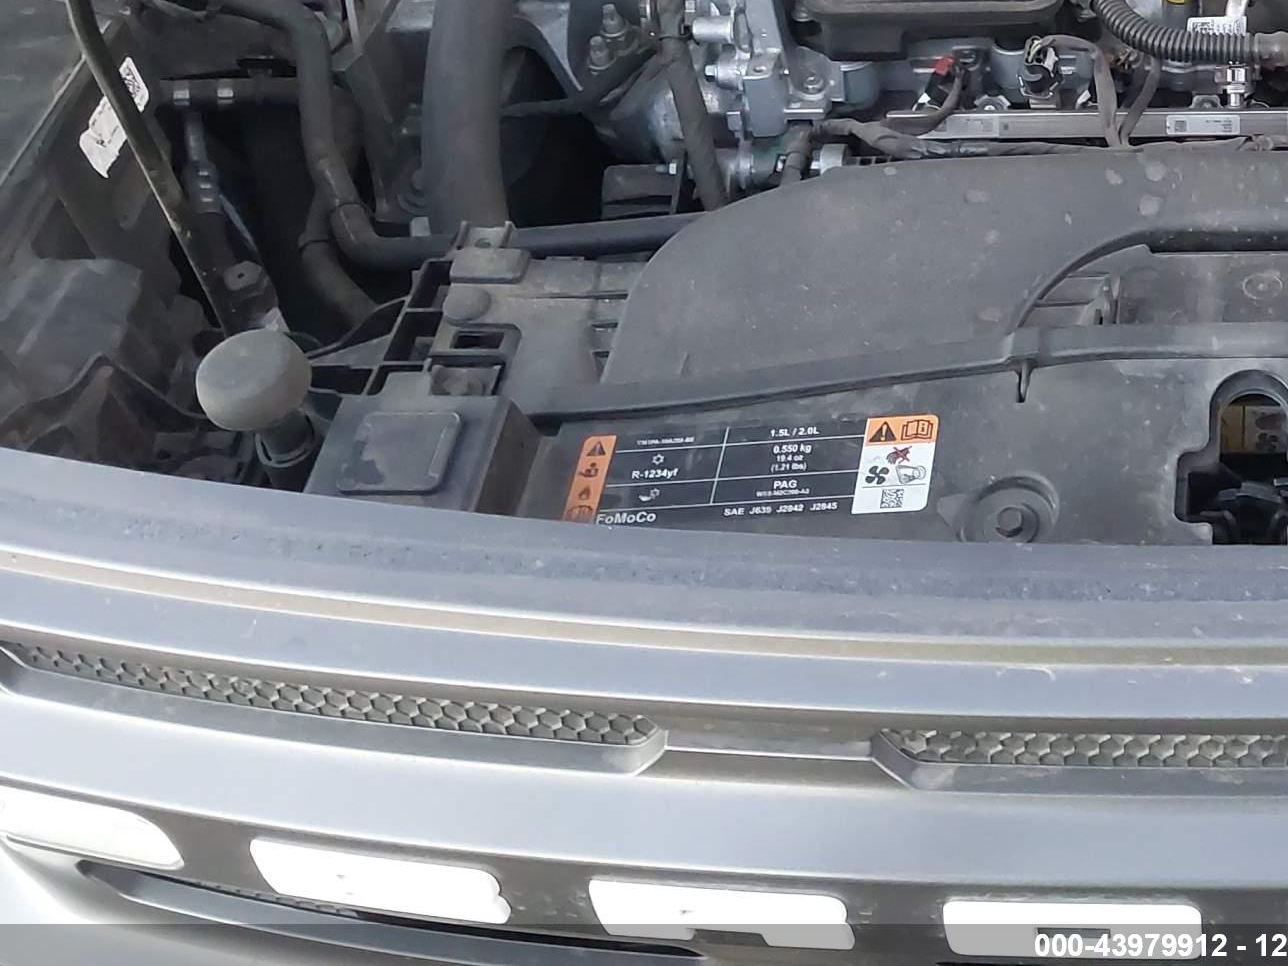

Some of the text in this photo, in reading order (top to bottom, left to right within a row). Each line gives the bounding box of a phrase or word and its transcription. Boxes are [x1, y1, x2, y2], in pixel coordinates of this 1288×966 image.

[770, 428, 790, 438] 1.5L
[798, 426, 820, 436] 2.0L
[773, 443, 813, 454] 0.550 kg
[776, 454, 793, 462] 19.4
[631, 468, 678, 480] R-1234yf
[773, 480, 798, 490] PAG
[723, 507, 745, 516] SAE
[596, 511, 657, 525] FoMoCo
